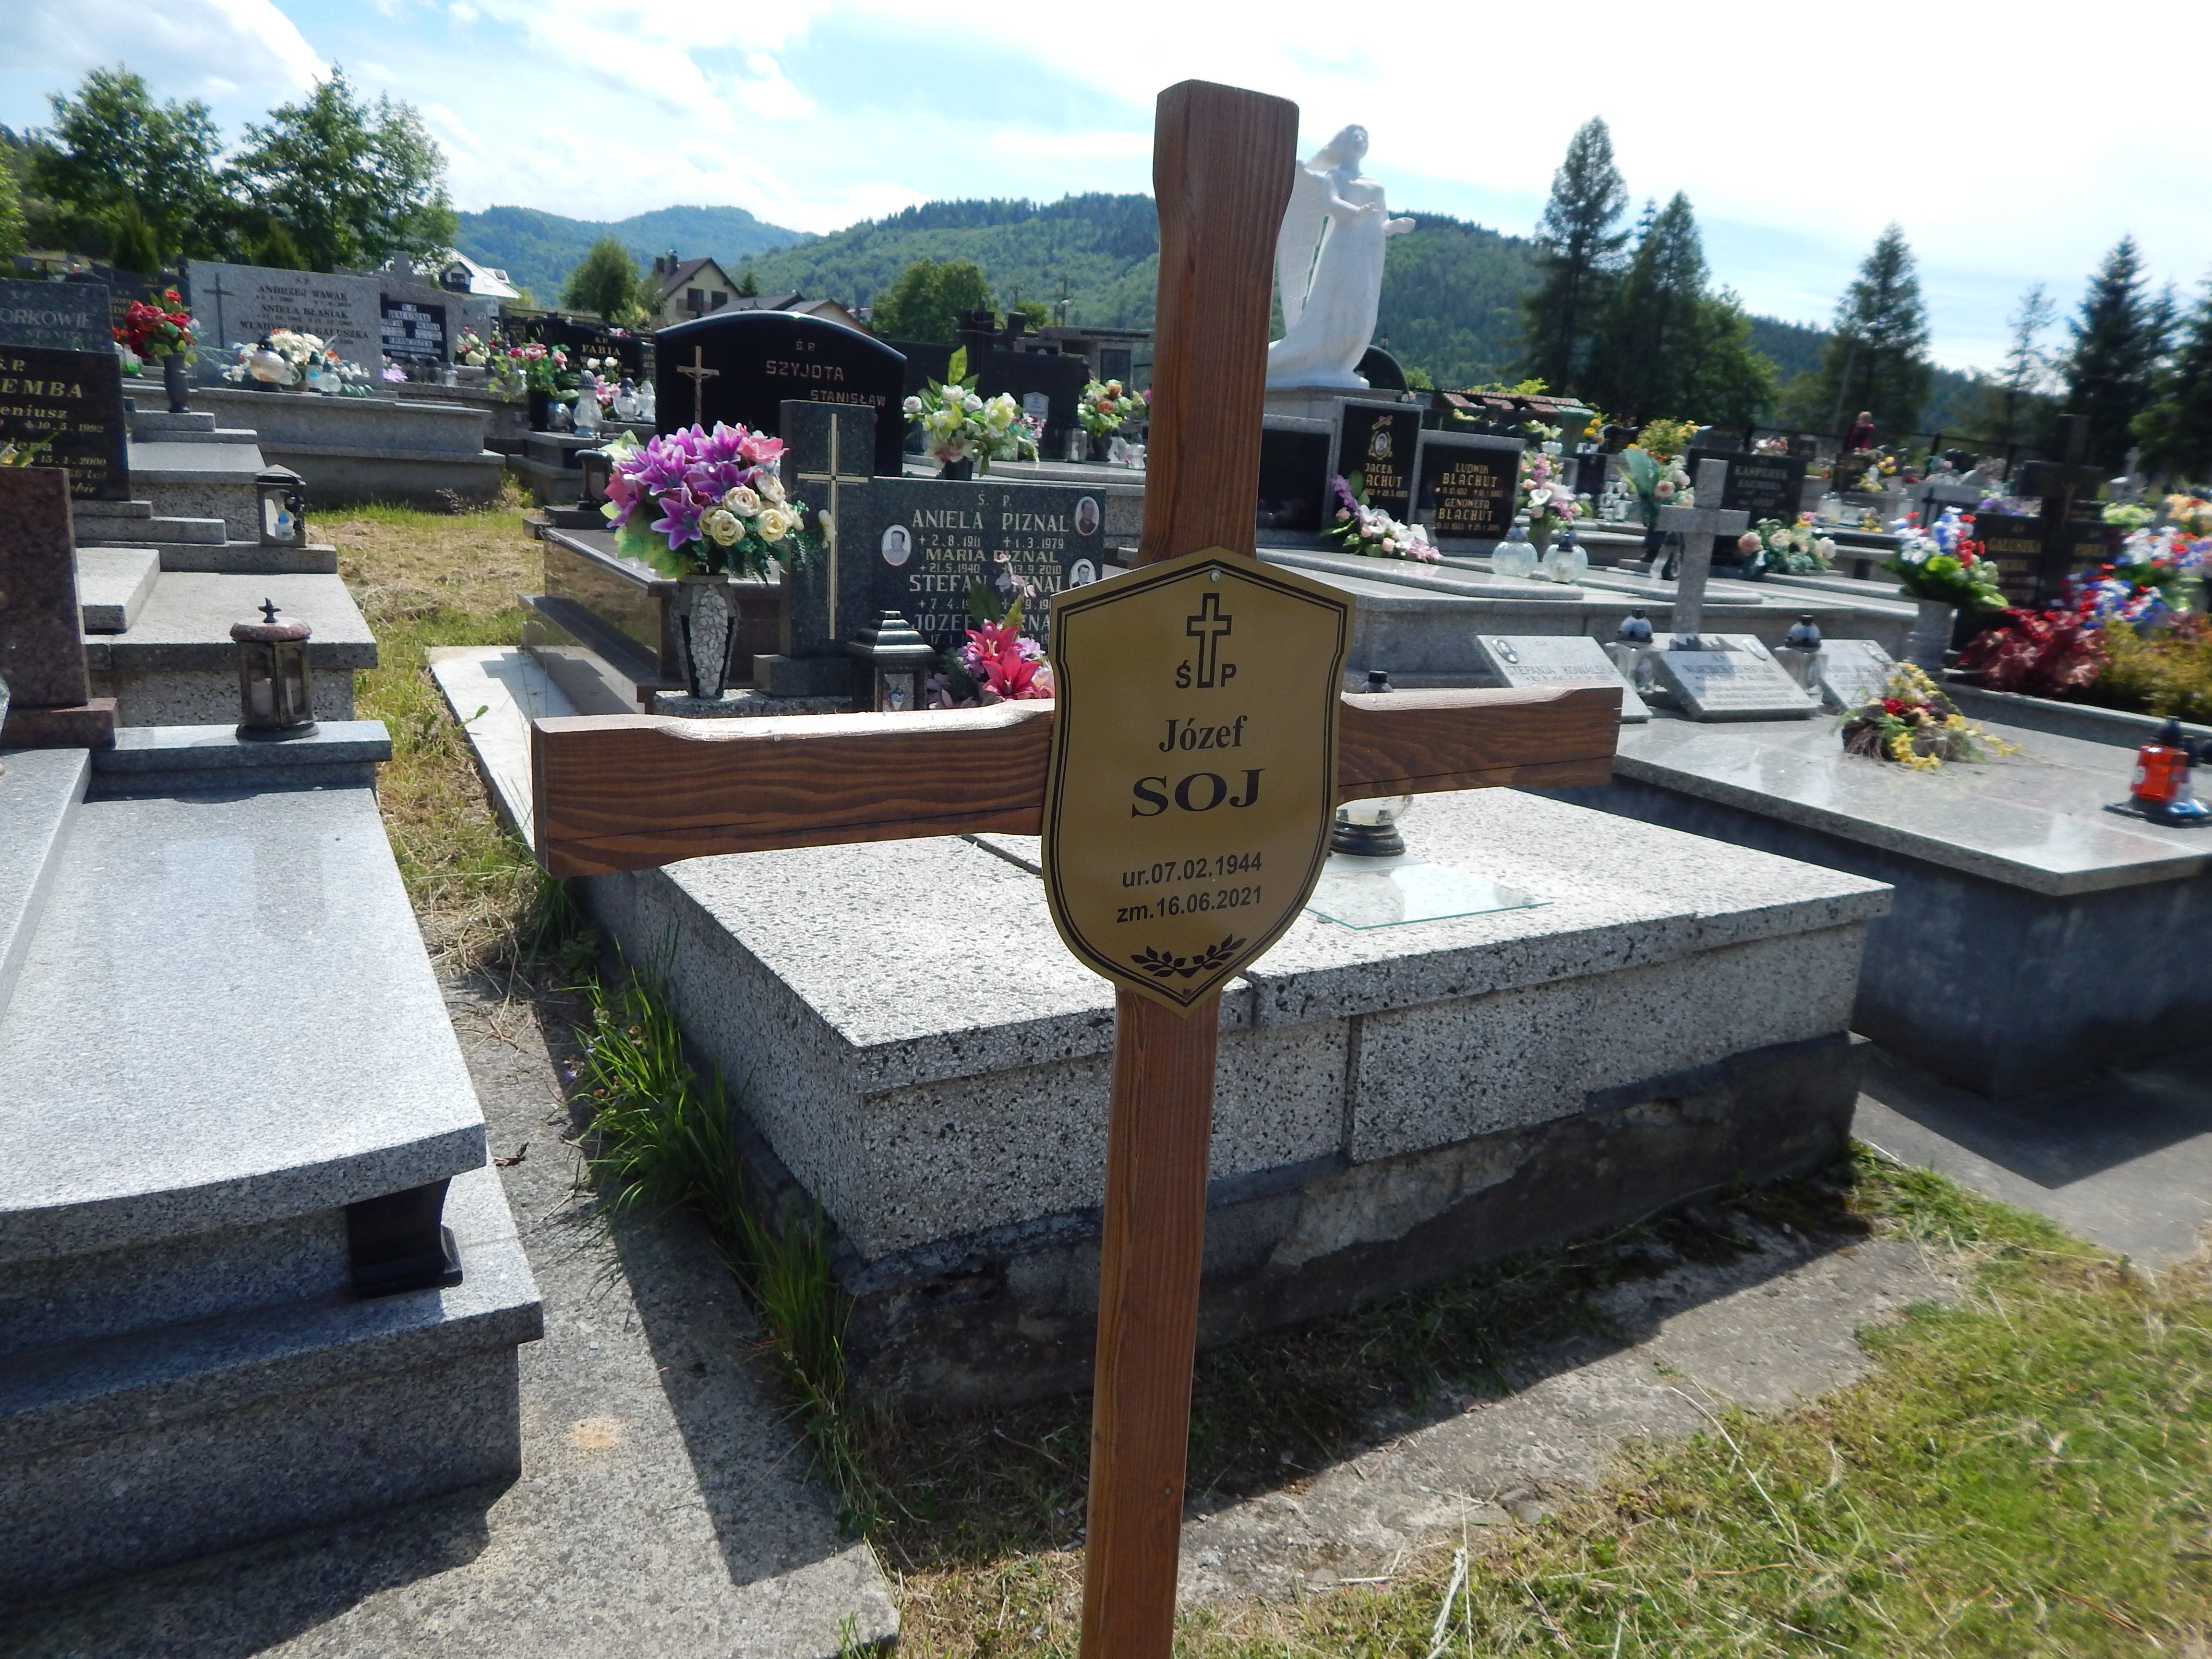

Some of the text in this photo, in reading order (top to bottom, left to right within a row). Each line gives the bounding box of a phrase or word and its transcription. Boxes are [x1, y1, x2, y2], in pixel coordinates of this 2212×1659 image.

[581, 344, 622, 356] FABIA
[766, 361, 844, 381] SZYJOTA
[810, 389, 886, 407] STANISŁAW
[1455, 462, 1489, 474] LUDWIK
[1366, 474, 1403, 488] ACHUT
[912, 509, 1070, 532] ANIELA PIZNAL
[926, 548, 986, 562] MARIA
[1175, 660, 1237, 689] Ś P
[1159, 715, 1249, 753] Józef
[1131, 768, 1267, 819] SOJ
[1122, 852, 1262, 888] ur.07.02.1944
[1117, 886, 1262, 923] zm.16.06.2021
